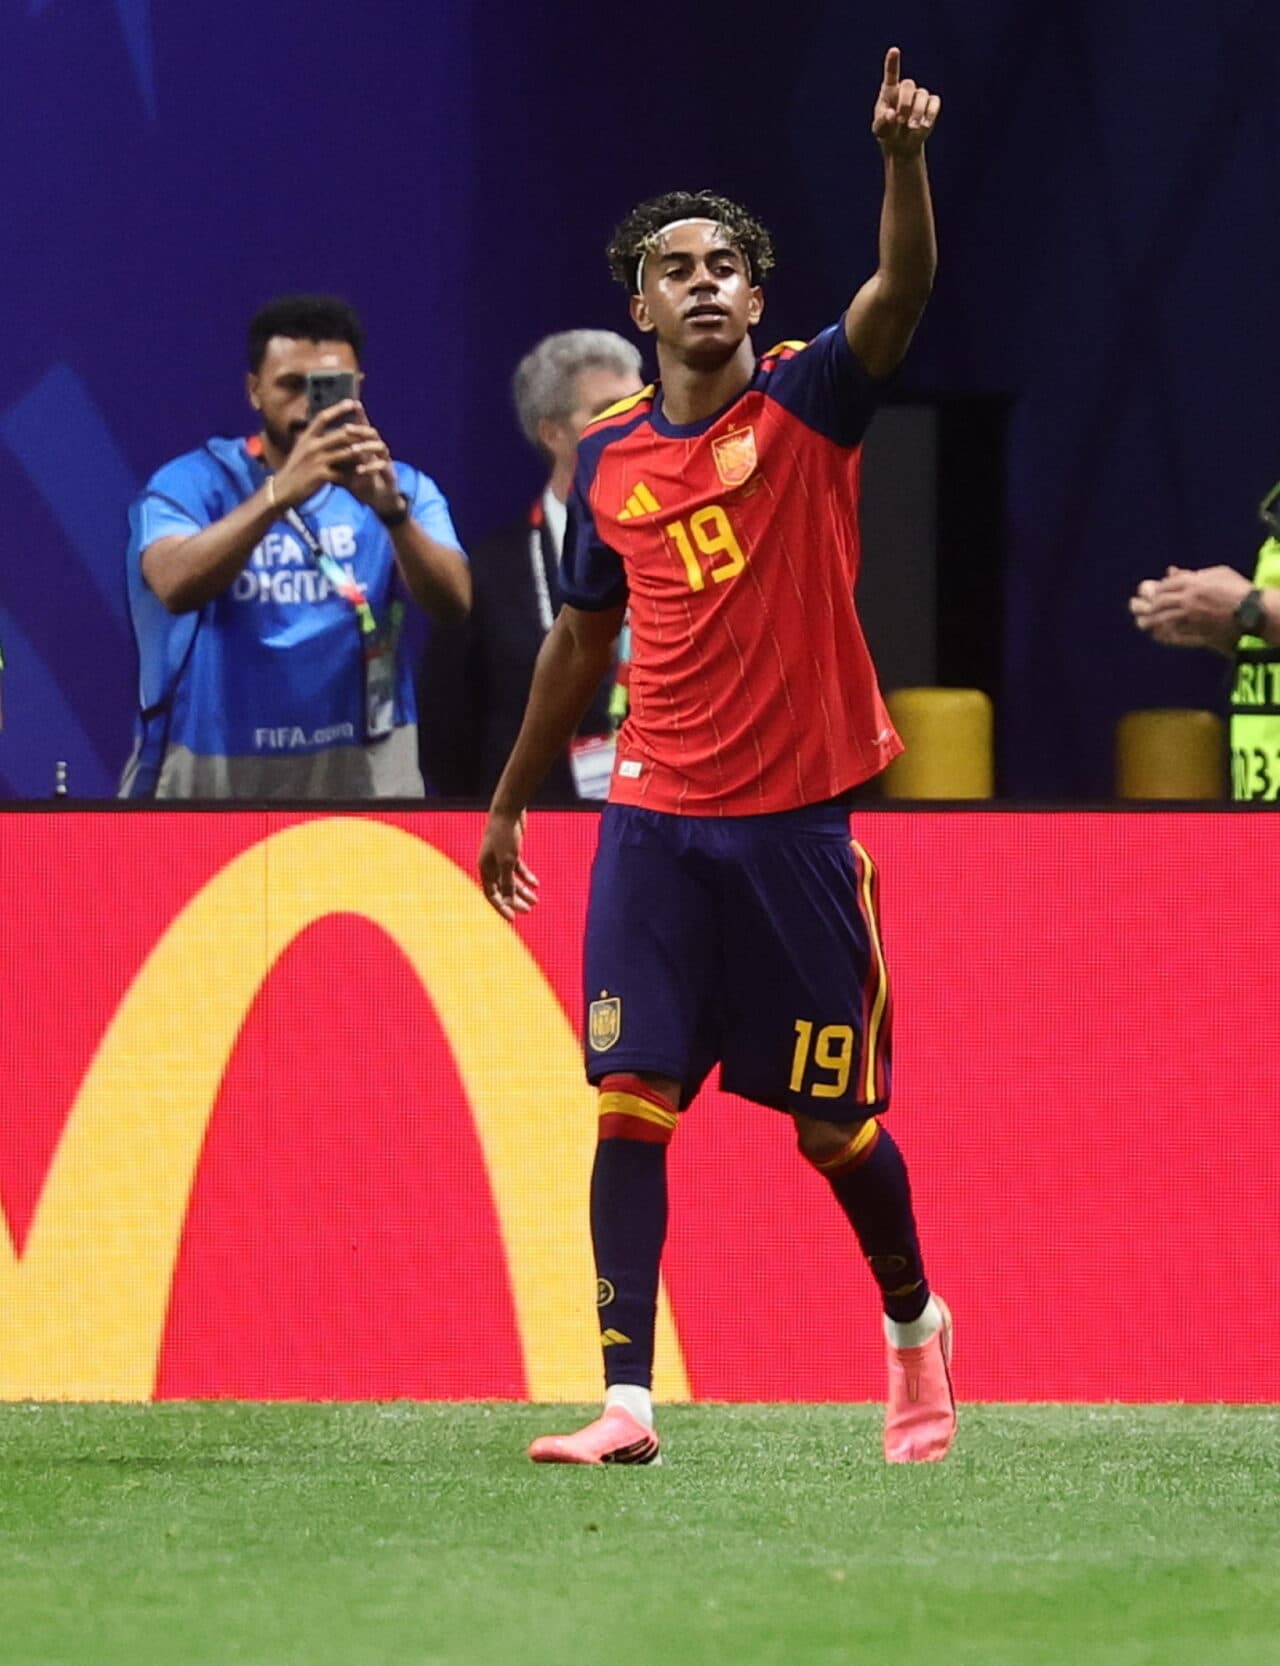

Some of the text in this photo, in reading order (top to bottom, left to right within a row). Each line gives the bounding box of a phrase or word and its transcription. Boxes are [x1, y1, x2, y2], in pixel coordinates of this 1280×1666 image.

[252, 532, 304, 567] IFA
[666, 504, 745, 592] 19
[789, 1019, 853, 1098] 19
